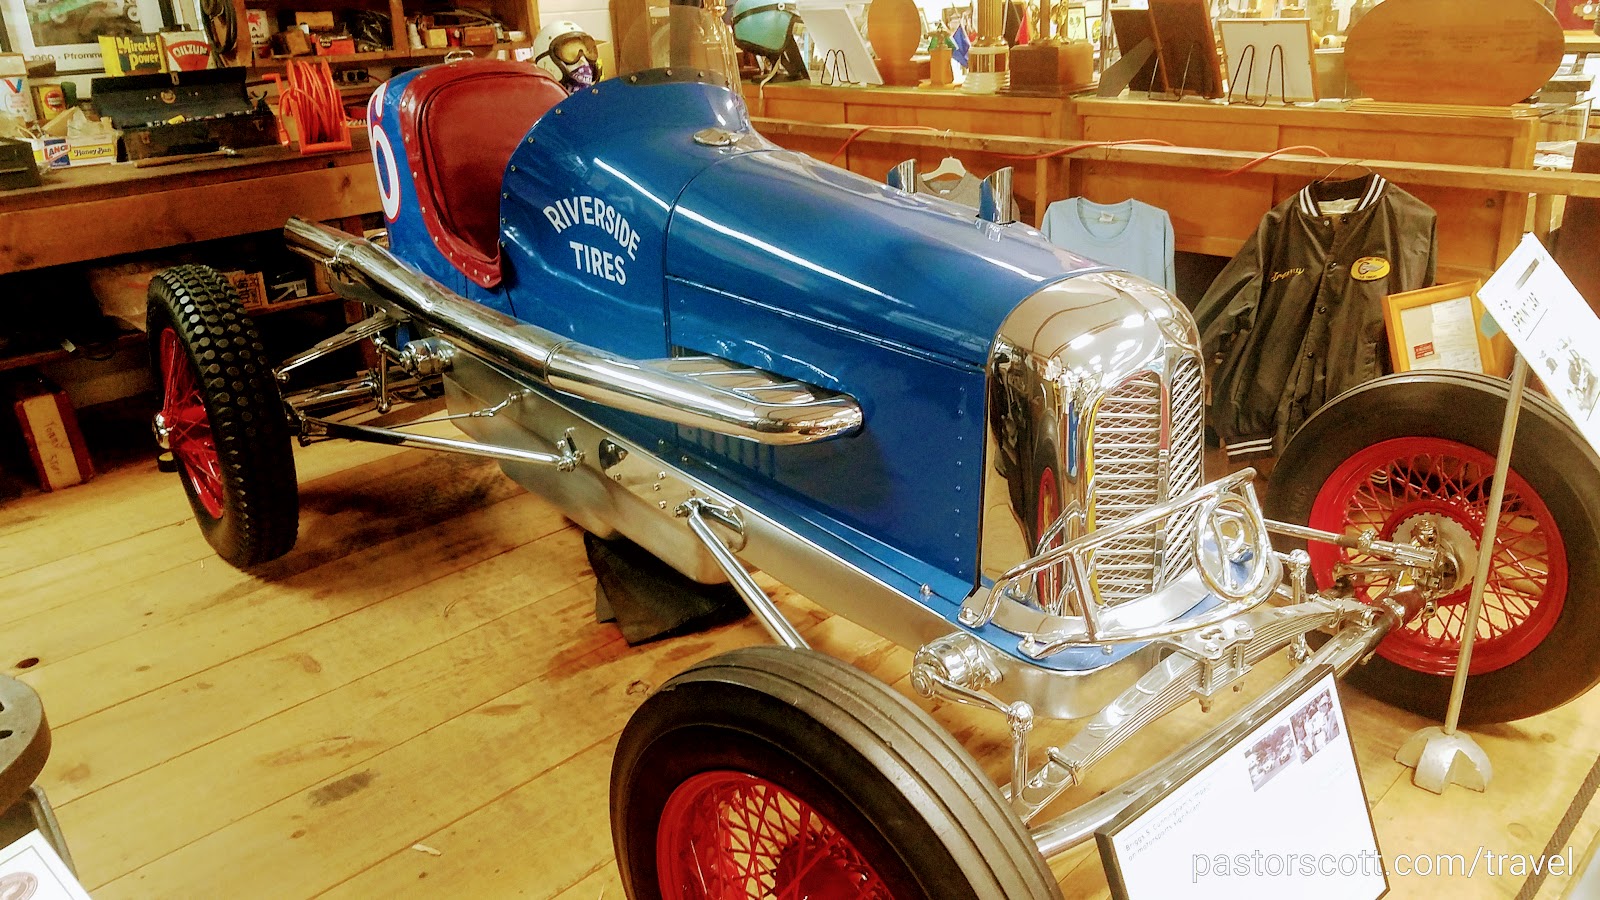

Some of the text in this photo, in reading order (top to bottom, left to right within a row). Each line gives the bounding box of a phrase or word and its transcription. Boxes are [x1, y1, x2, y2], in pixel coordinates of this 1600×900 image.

[116, 36, 156, 54] Miracle
[172, 43, 207, 57] OILZUM
[129, 53, 159, 70] Power
[543, 196, 640, 261] RIVERSIDE
[569, 241, 626, 286] TIRES
[1125, 835, 1145, 851] Briggs
